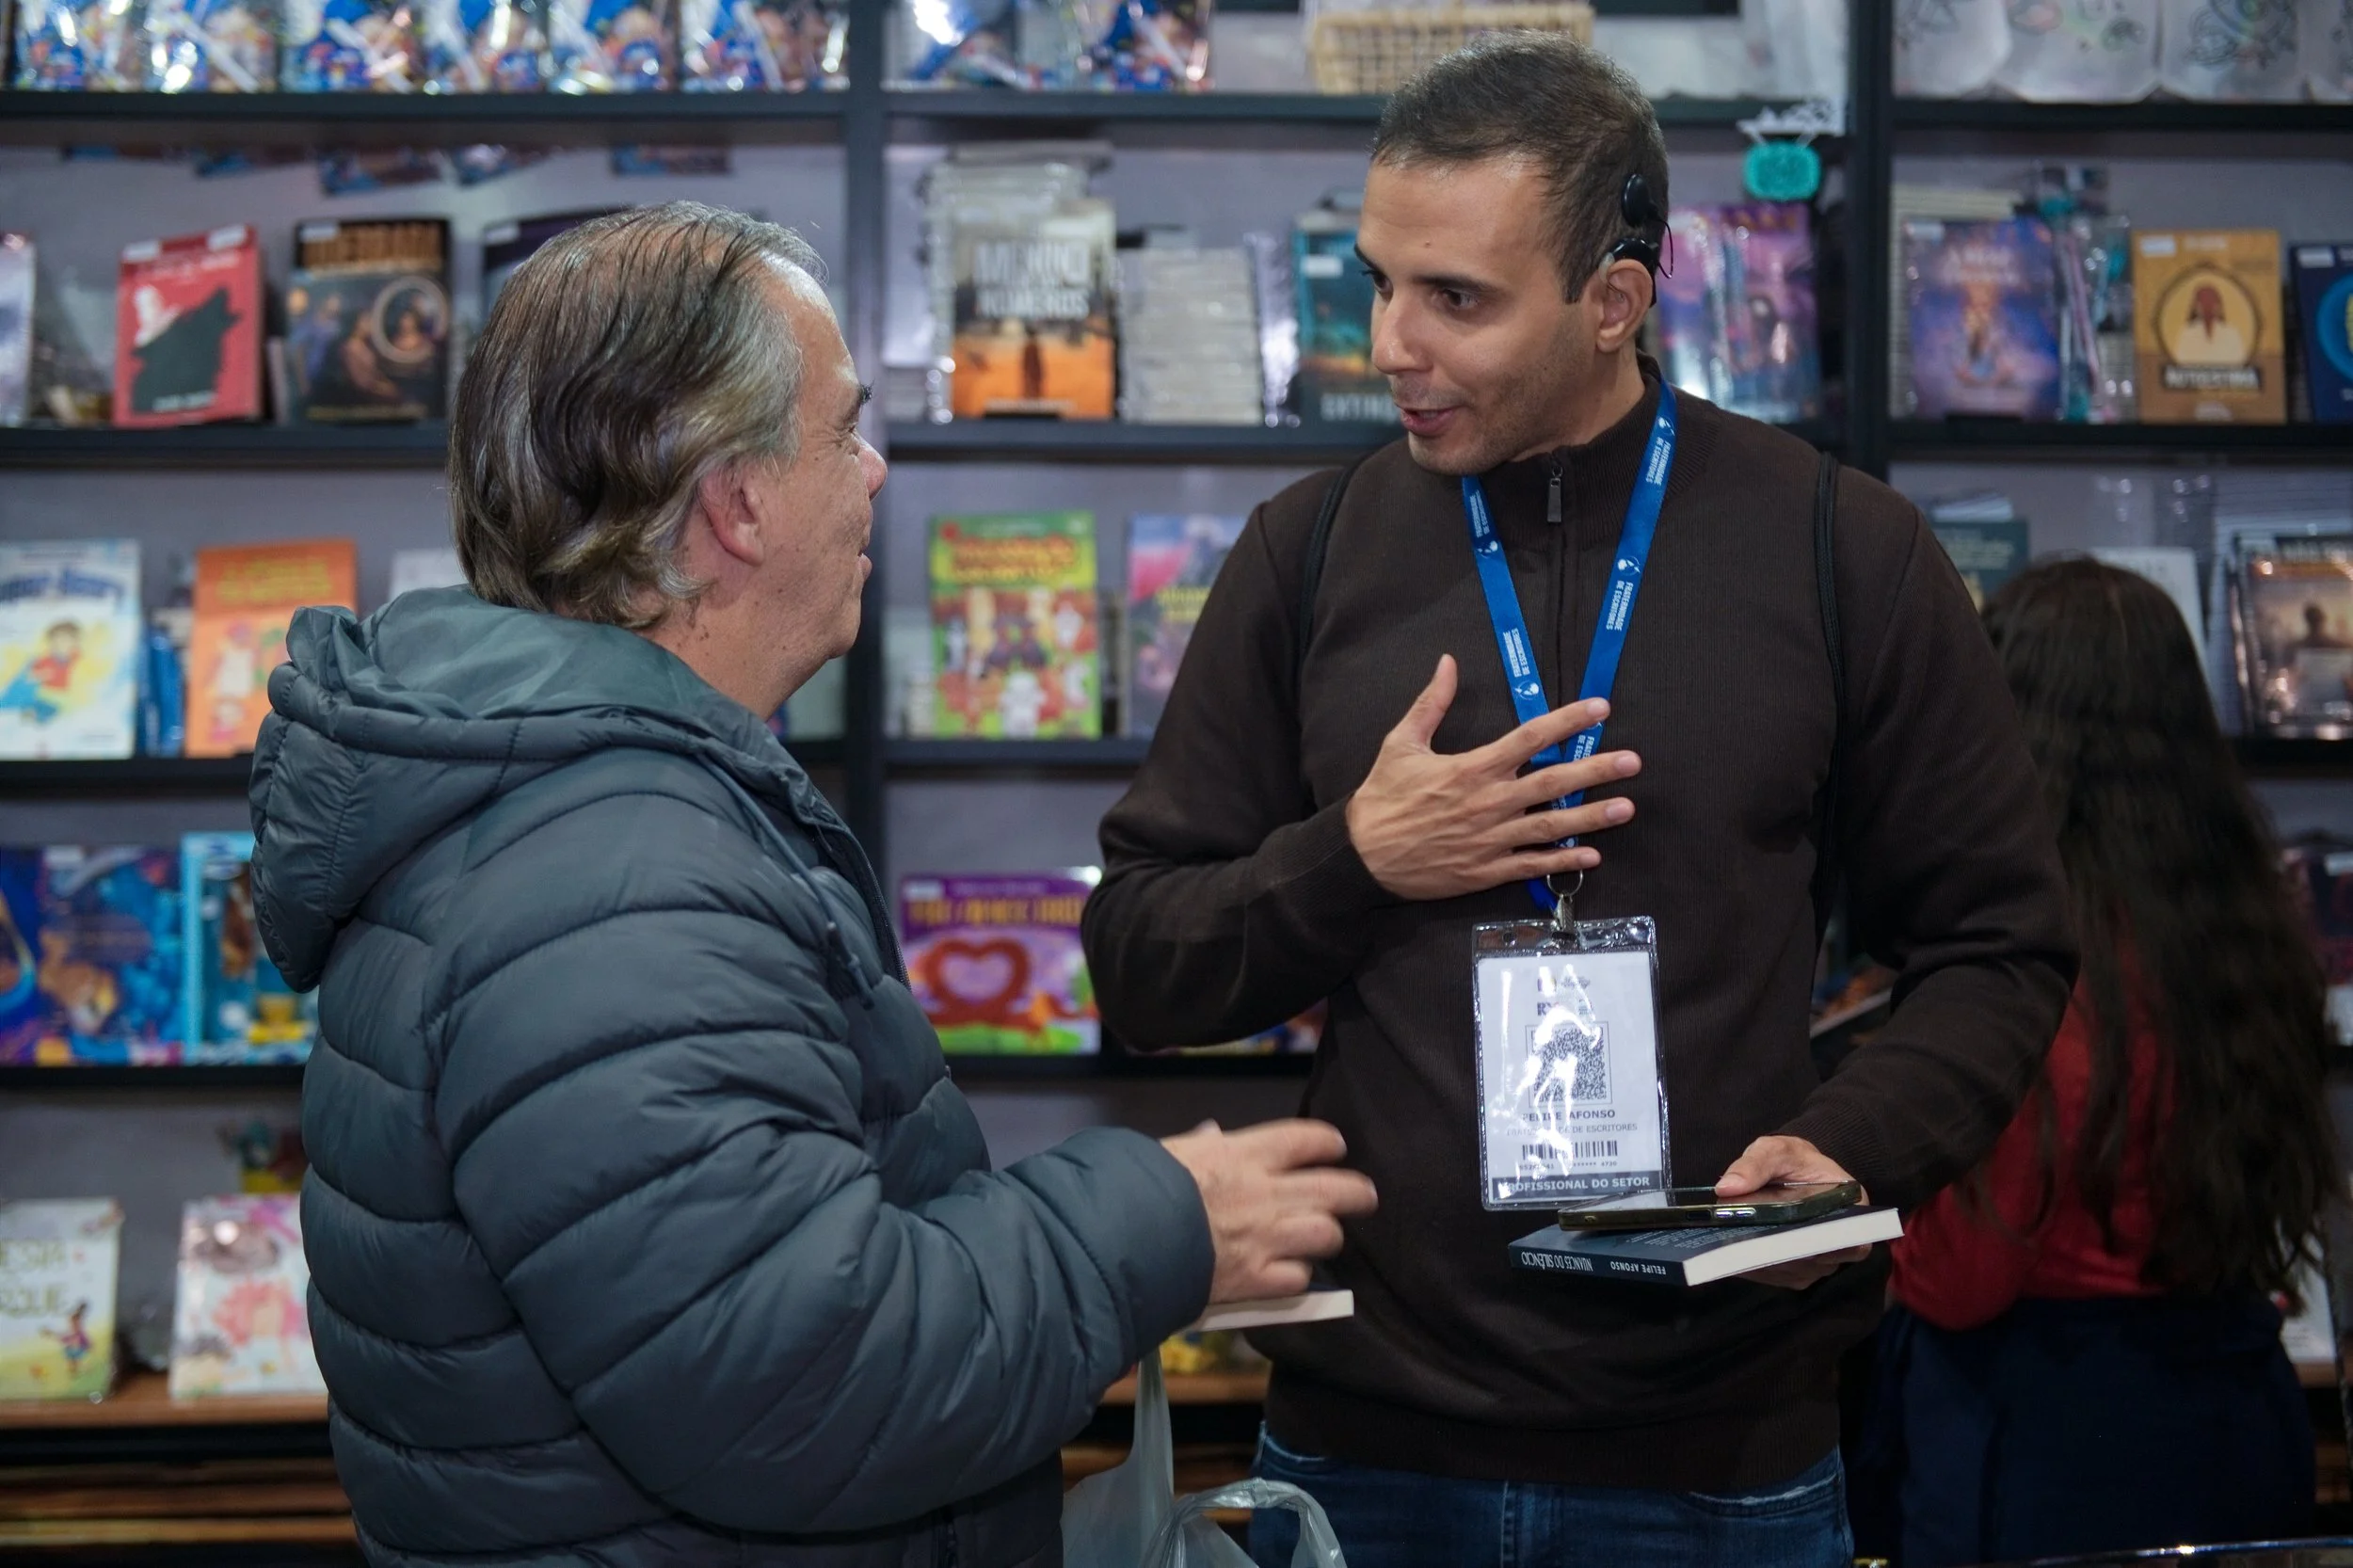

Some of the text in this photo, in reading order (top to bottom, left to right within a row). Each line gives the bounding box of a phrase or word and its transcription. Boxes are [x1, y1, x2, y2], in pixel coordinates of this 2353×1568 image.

[1616, 580, 1625, 589] DE
[1615, 581, 1634, 632] FRATERNIDADE
[1569, 1110, 1616, 1121] AFONSO
[1572, 1126, 1583, 1134] DE
[1586, 1123, 1638, 1133] ESCRITORES
[1502, 1176, 1650, 1192] ROFISSIONAL DO SETOR
[1521, 1251, 1593, 1272] NUANCES DO SILÊNCIO
[1610, 1261, 1667, 1275] FELIPE AFONSO
